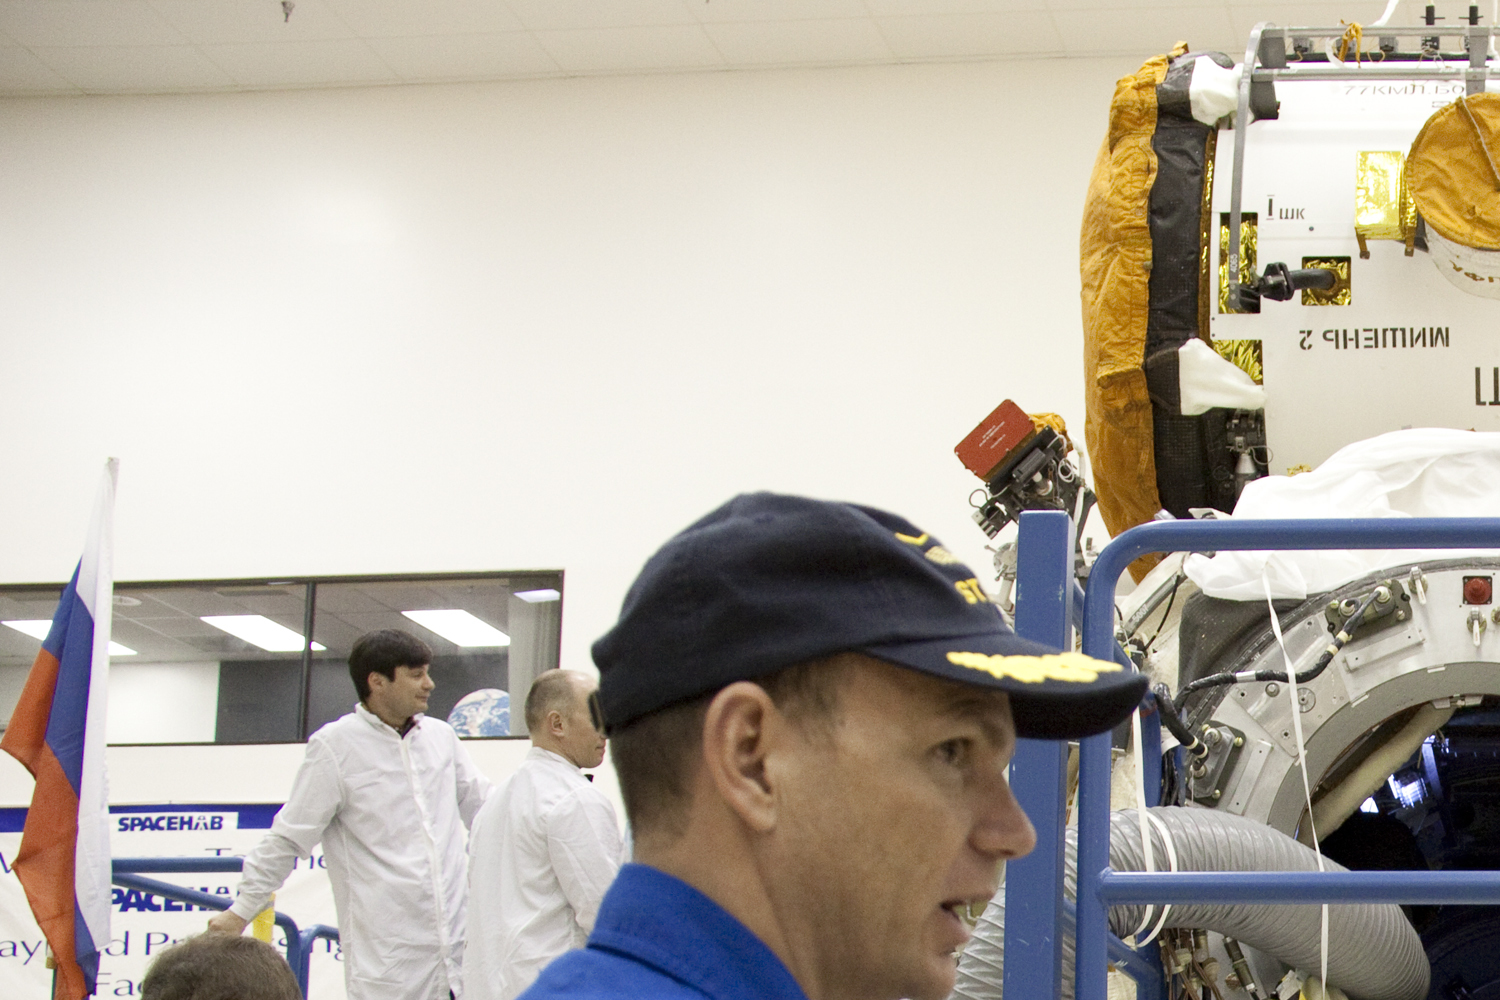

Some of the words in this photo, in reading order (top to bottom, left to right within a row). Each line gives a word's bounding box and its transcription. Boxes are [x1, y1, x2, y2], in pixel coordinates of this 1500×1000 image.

[1299, 329, 1313, 350] 2
[1322, 327, 1450, 350] МИШЕНЬ
[118, 816, 224, 832] SPACEHAB
